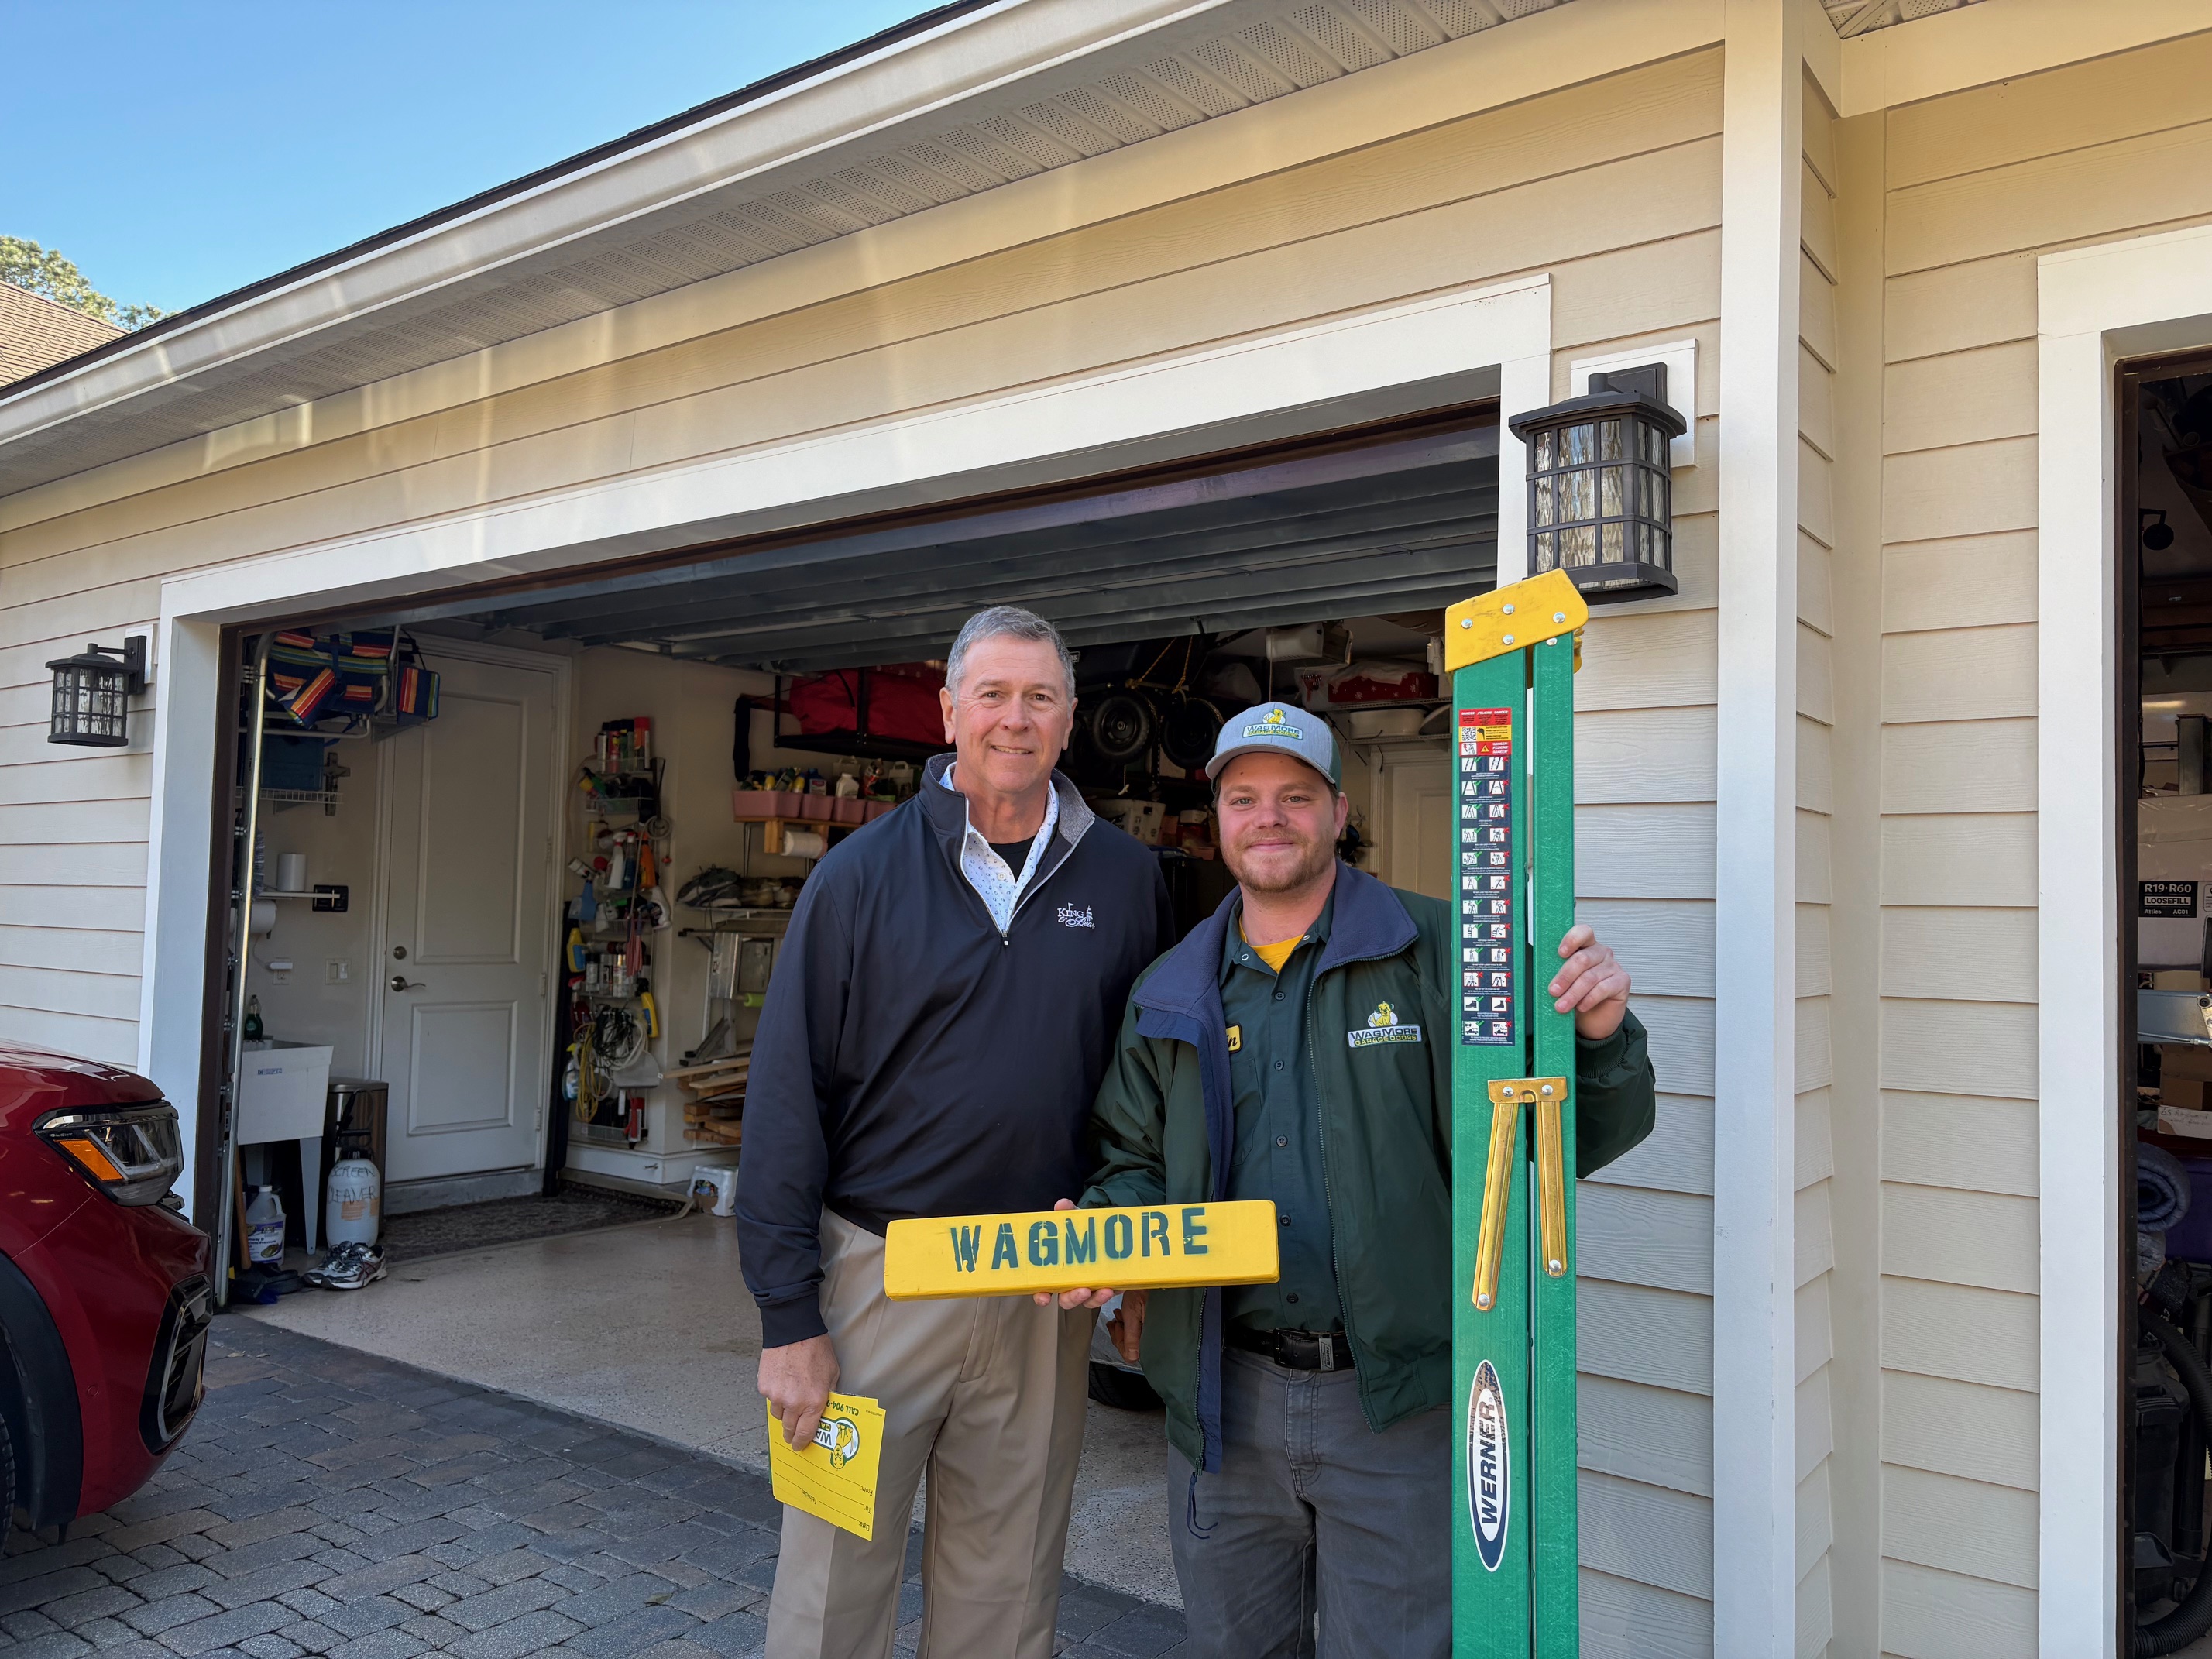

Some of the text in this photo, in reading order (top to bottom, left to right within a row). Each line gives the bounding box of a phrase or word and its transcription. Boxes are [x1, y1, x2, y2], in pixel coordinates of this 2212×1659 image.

[2169, 884, 2192, 893] R60
[1355, 1036, 1389, 1046] GARAGE
[330, 1165, 376, 1178] SCREEN
[327, 1184, 379, 1205] CLEANER
[950, 1207, 1208, 1273] WAGMORE
[846, 1405, 860, 1417] CALL
[1479, 1400, 1498, 1524] WERNER
[860, 1486, 874, 1496] From:
